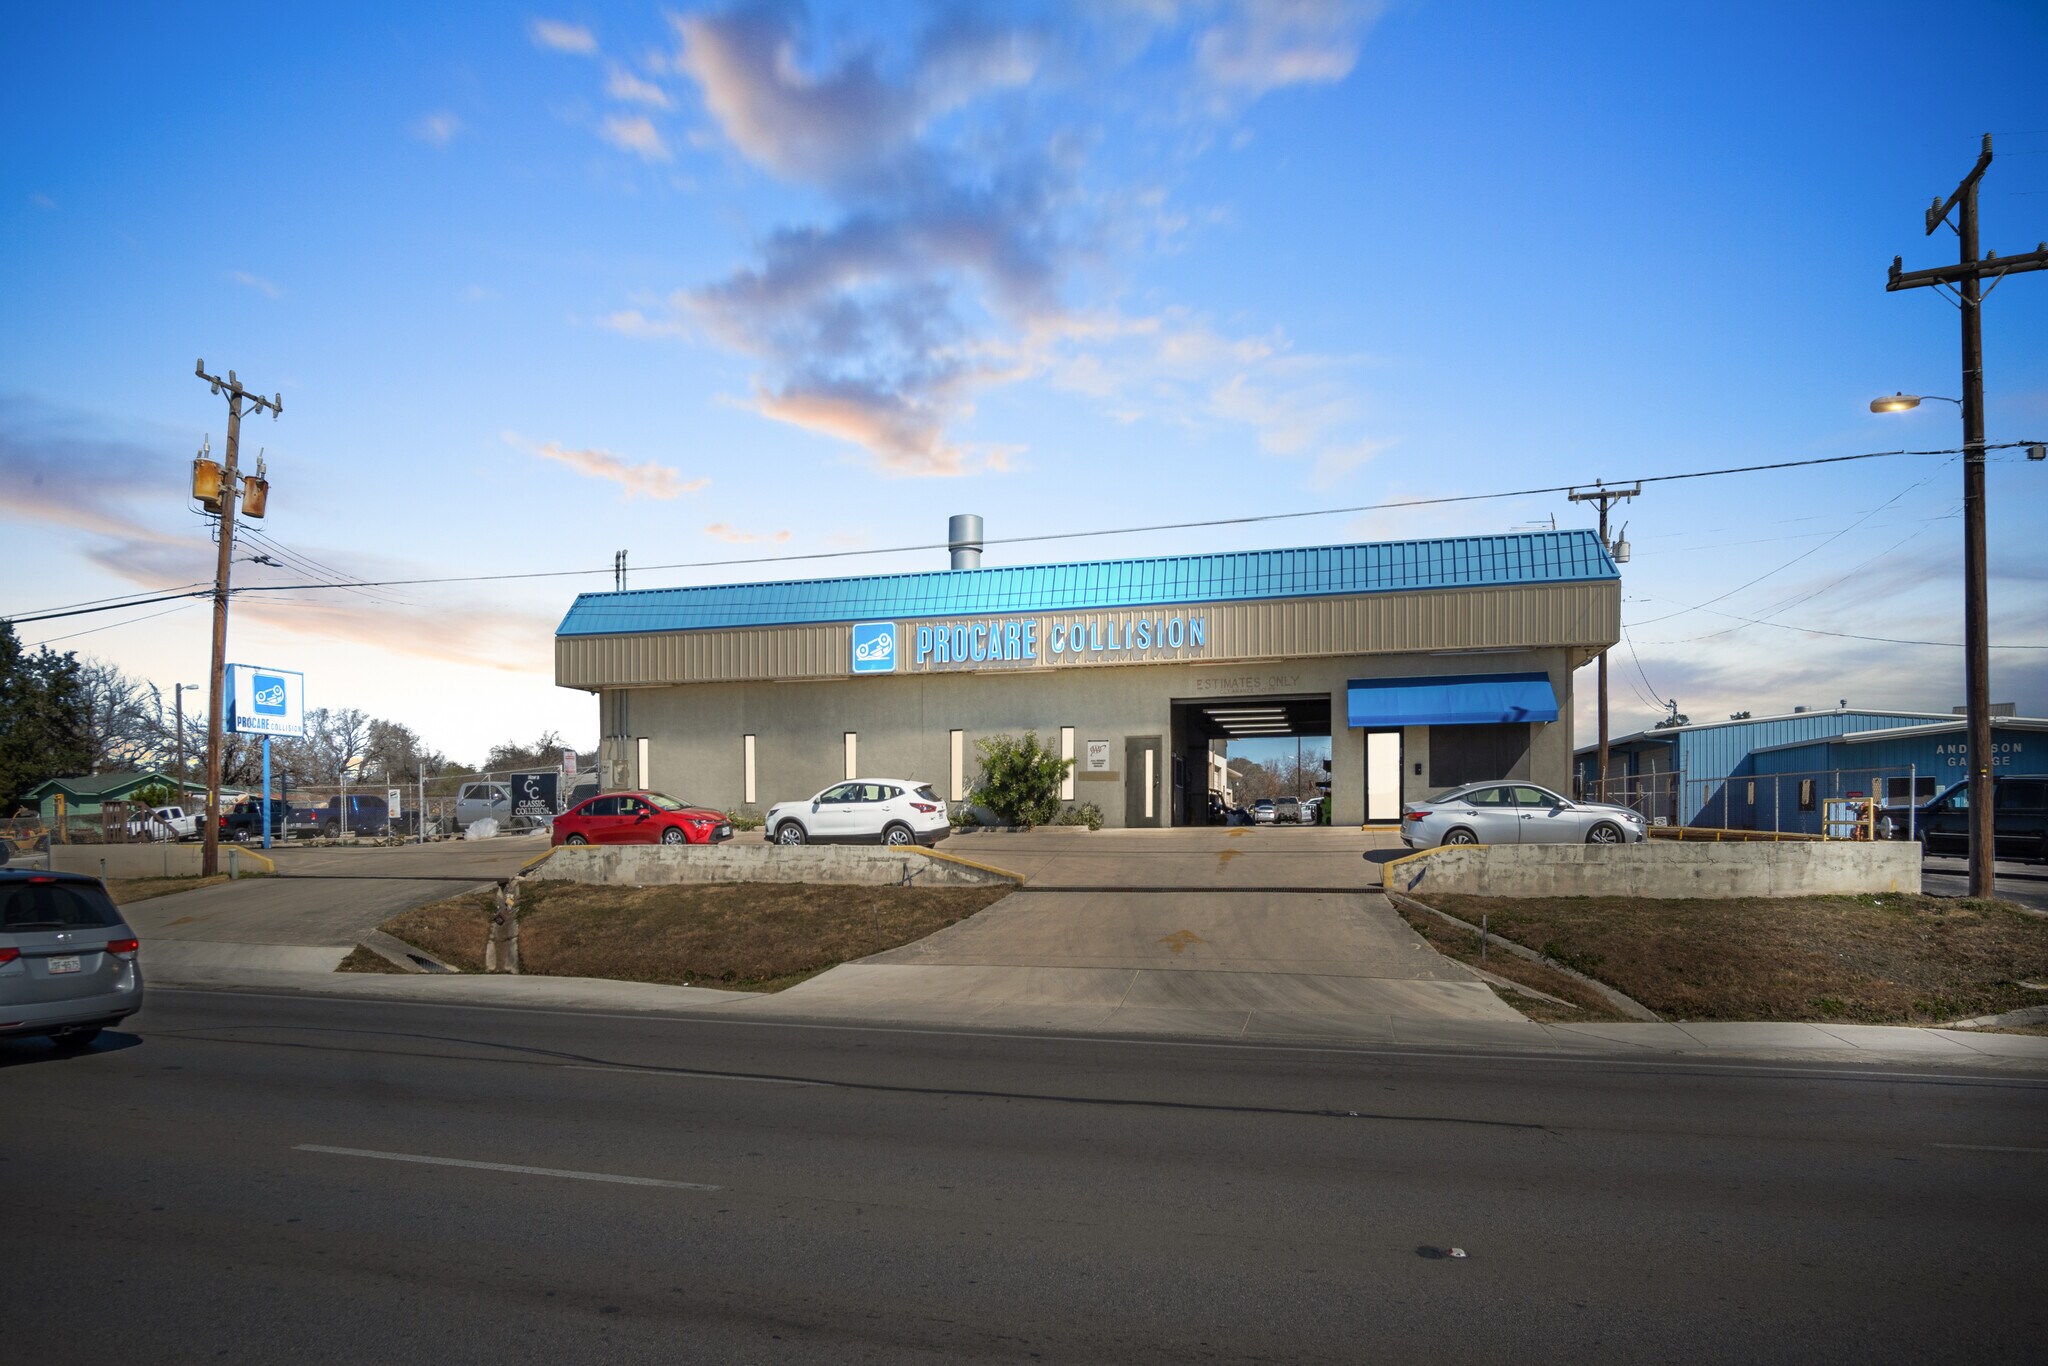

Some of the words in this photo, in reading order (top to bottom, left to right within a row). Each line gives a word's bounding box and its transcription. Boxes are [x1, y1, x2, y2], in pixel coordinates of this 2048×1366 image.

[916, 620, 1037, 664] PROCARE
[1051, 616, 1205, 654] COLLISION
[1196, 677, 1261, 690] ESTIMATES
[1268, 675, 1300, 688] ONLY
[237, 716, 270, 730] PROCARE
[270, 723, 302, 732] COLLISION
[1936, 743, 2022, 754] ANDSON
[1947, 756, 2010, 767] GAGE
